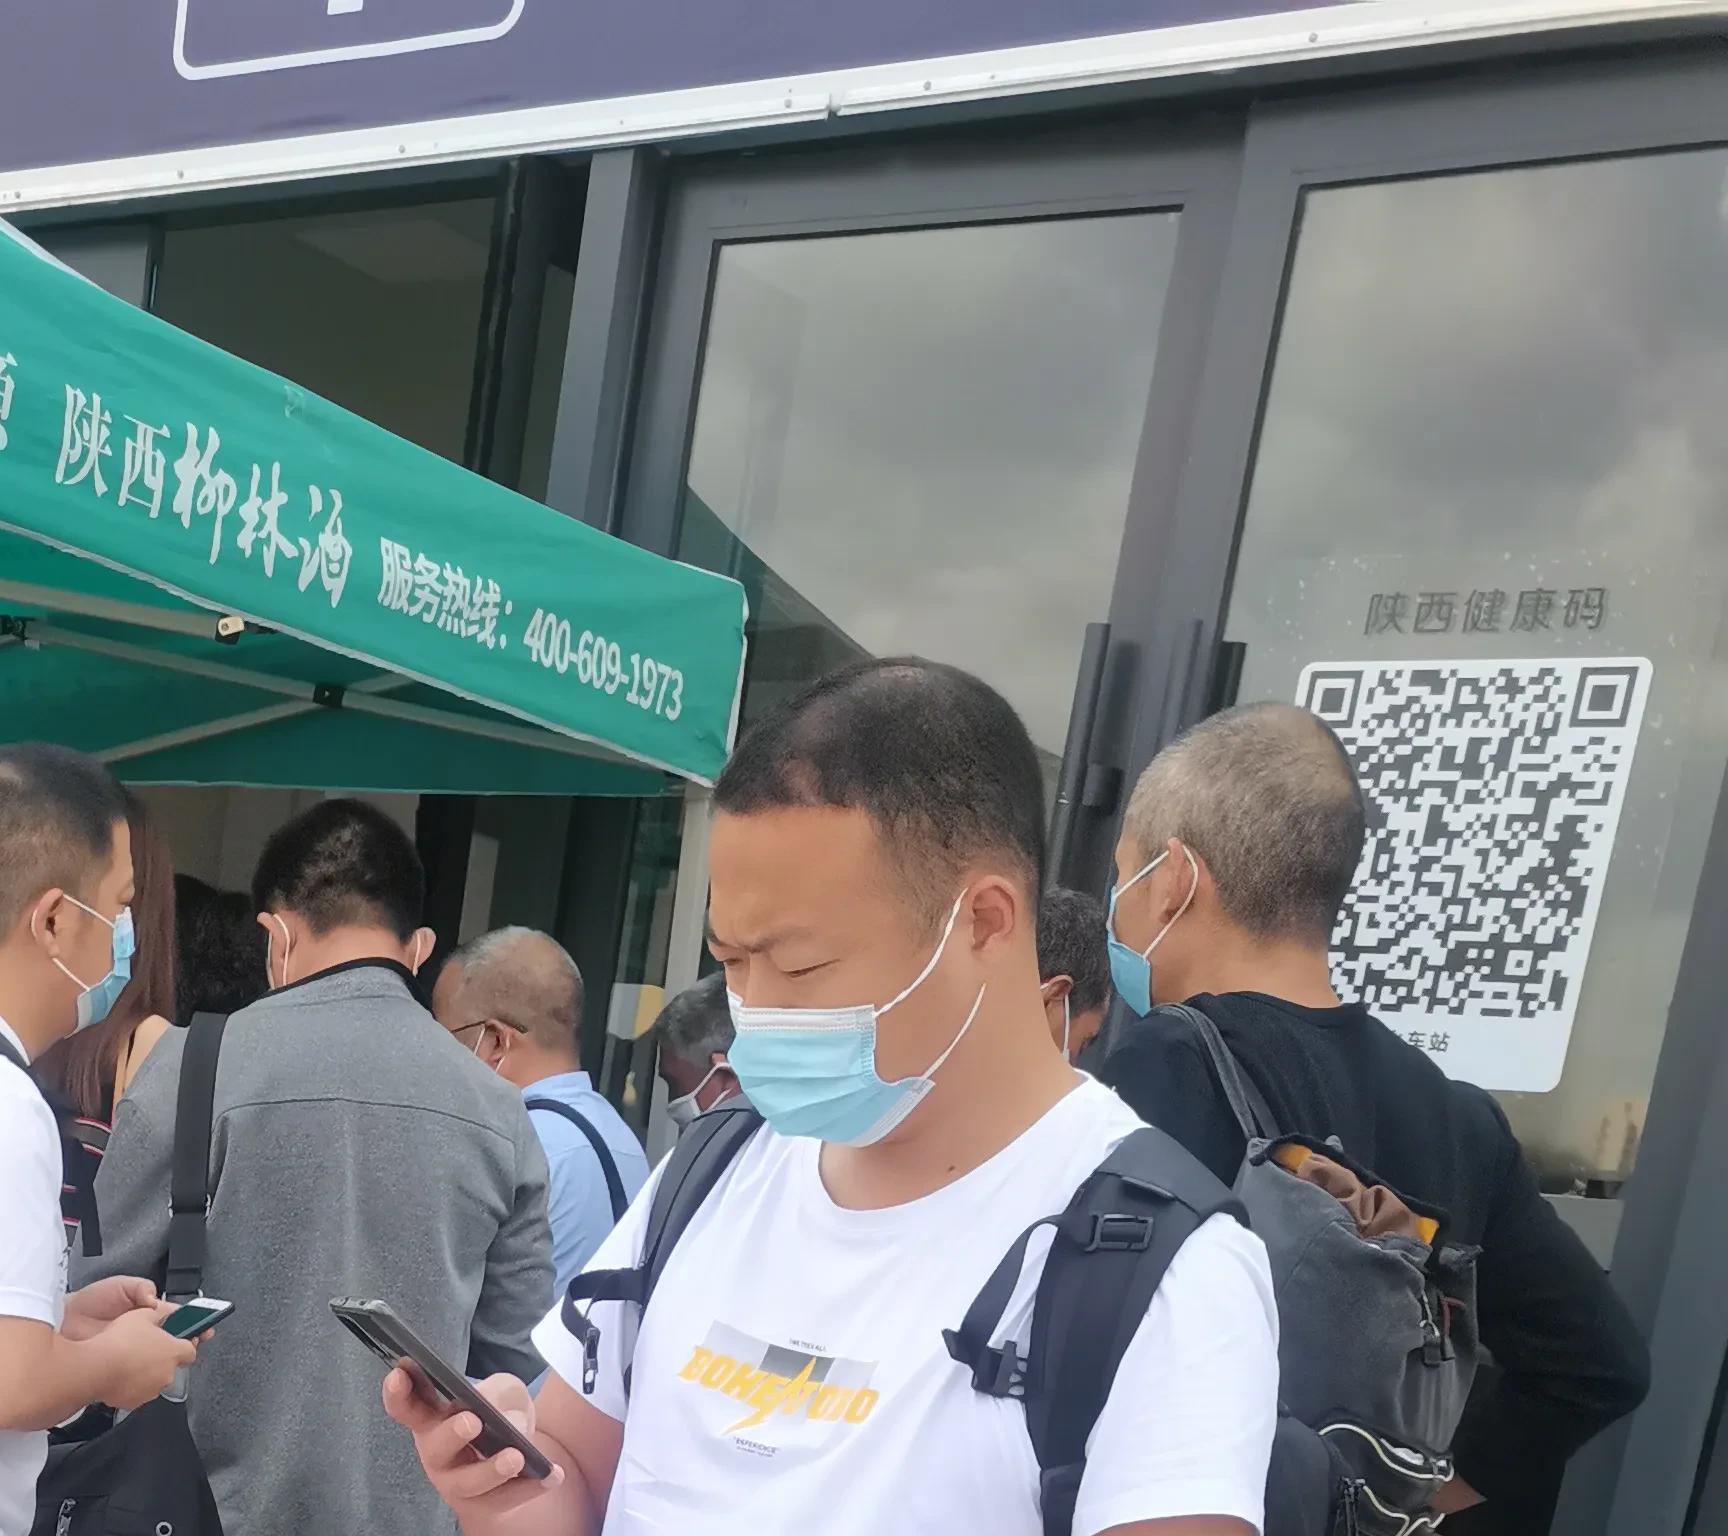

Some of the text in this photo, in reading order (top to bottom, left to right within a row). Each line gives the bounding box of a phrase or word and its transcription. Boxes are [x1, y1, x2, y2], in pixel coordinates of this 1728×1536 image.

[55, 383, 353, 608] 陕西柳林酒
[522, 608, 684, 722] 400-609-1973
[1363, 587, 1610, 636] 陕西健康码
